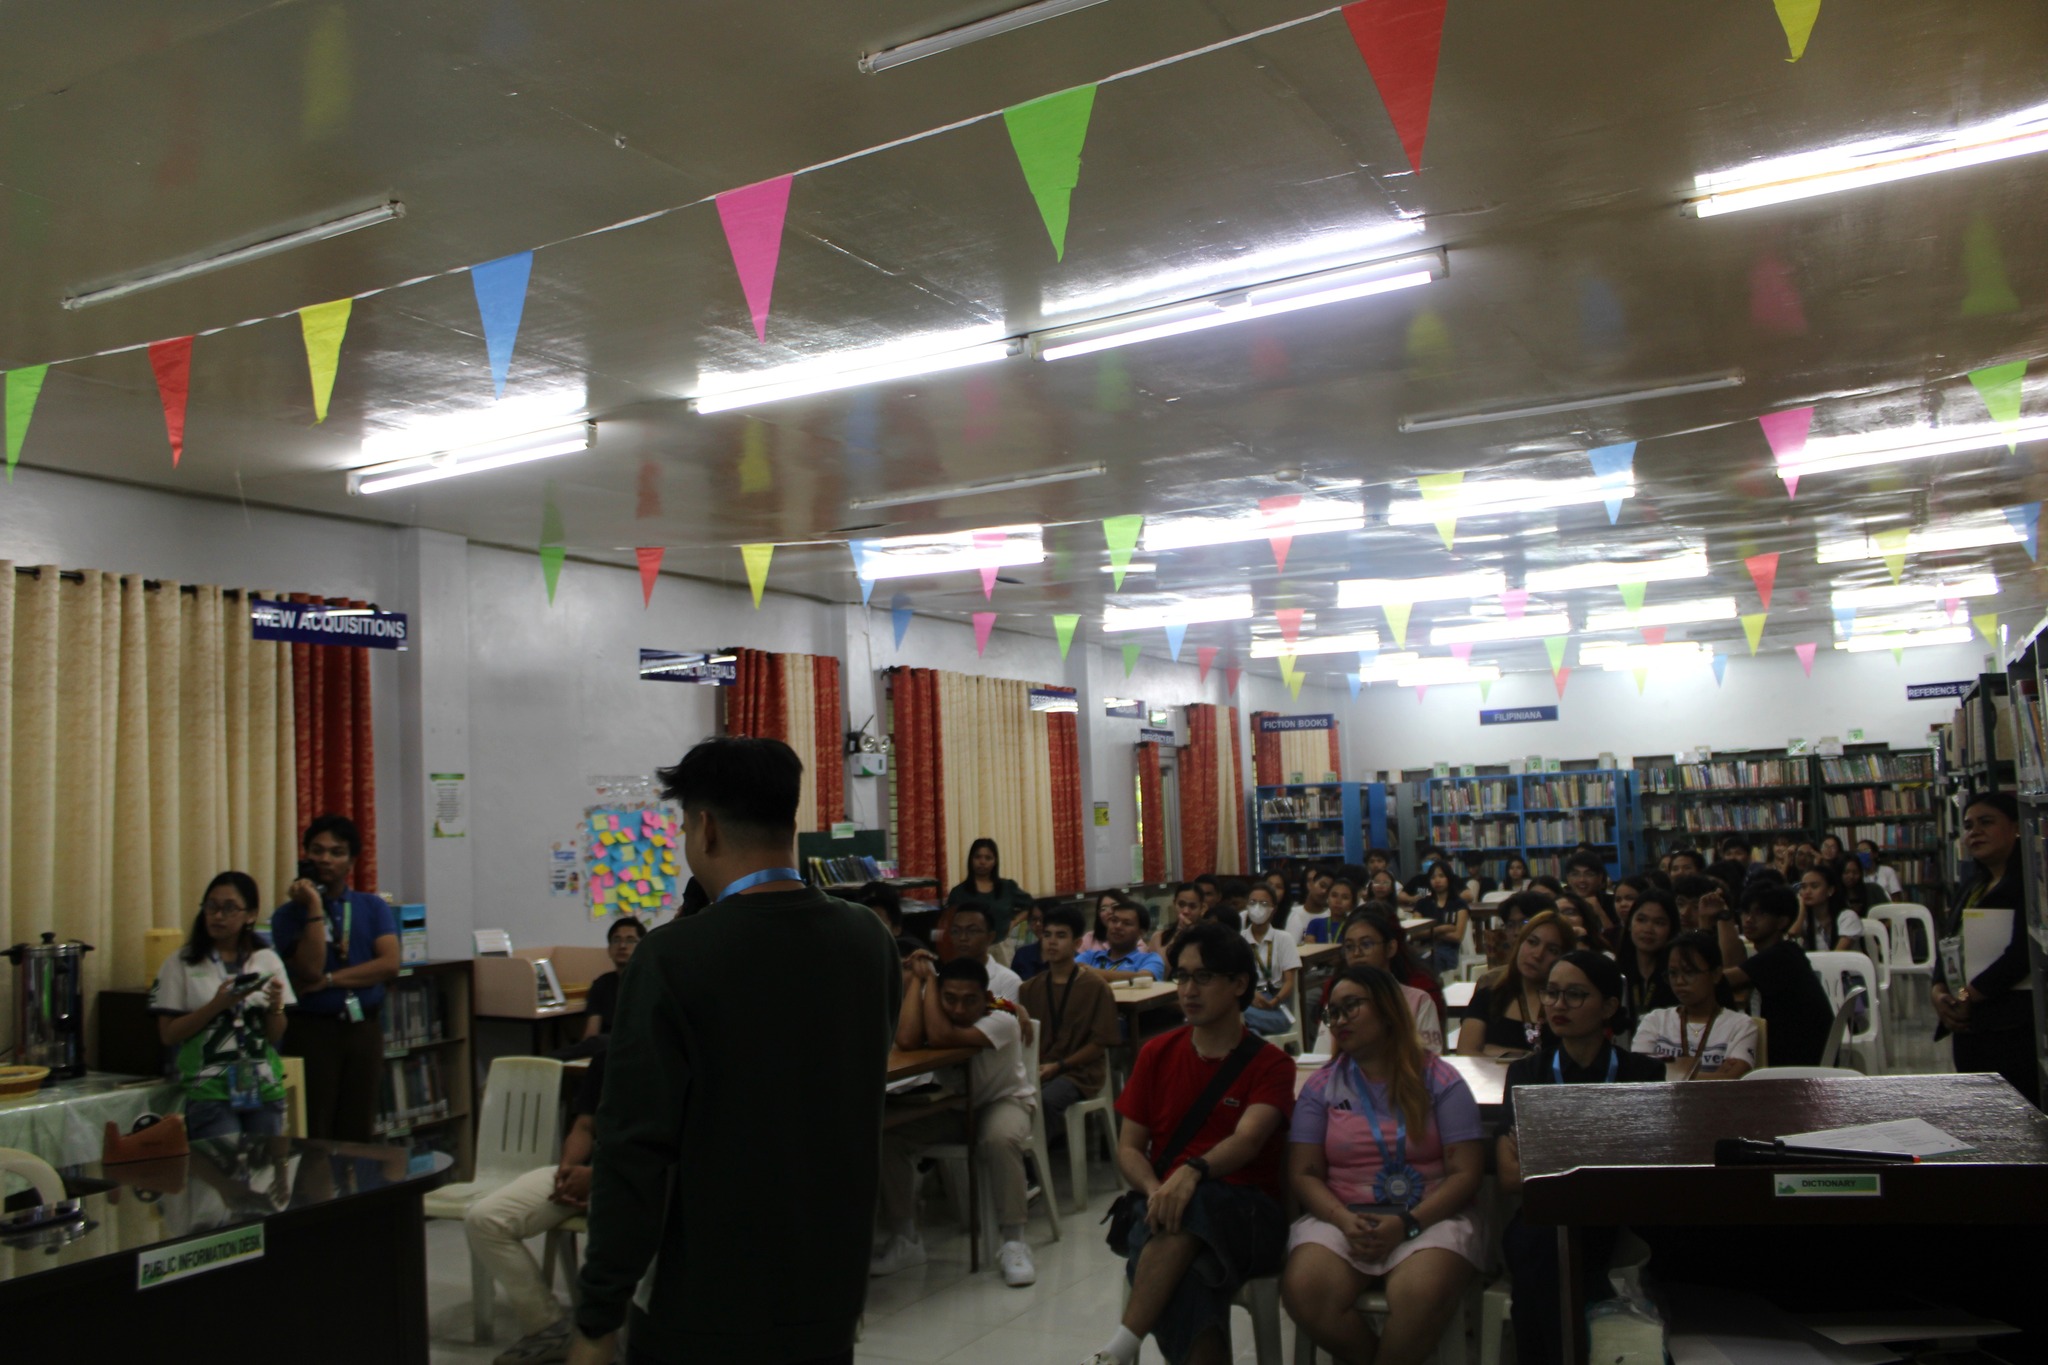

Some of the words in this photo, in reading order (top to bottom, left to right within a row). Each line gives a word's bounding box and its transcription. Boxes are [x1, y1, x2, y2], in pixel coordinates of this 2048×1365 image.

[256, 606, 296, 629] NEW
[298, 612, 405, 638] ACQUISITIONS
[1908, 686, 1957, 697] REFERENCE
[1494, 711, 1542, 721] FILIPINIANA
[1264, 720, 1296, 729] FICTION
[1298, 719, 1328, 728] BOOKS
[143, 1255, 177, 1281] PUBLIC
[178, 1239, 237, 1269] INFORMATION
